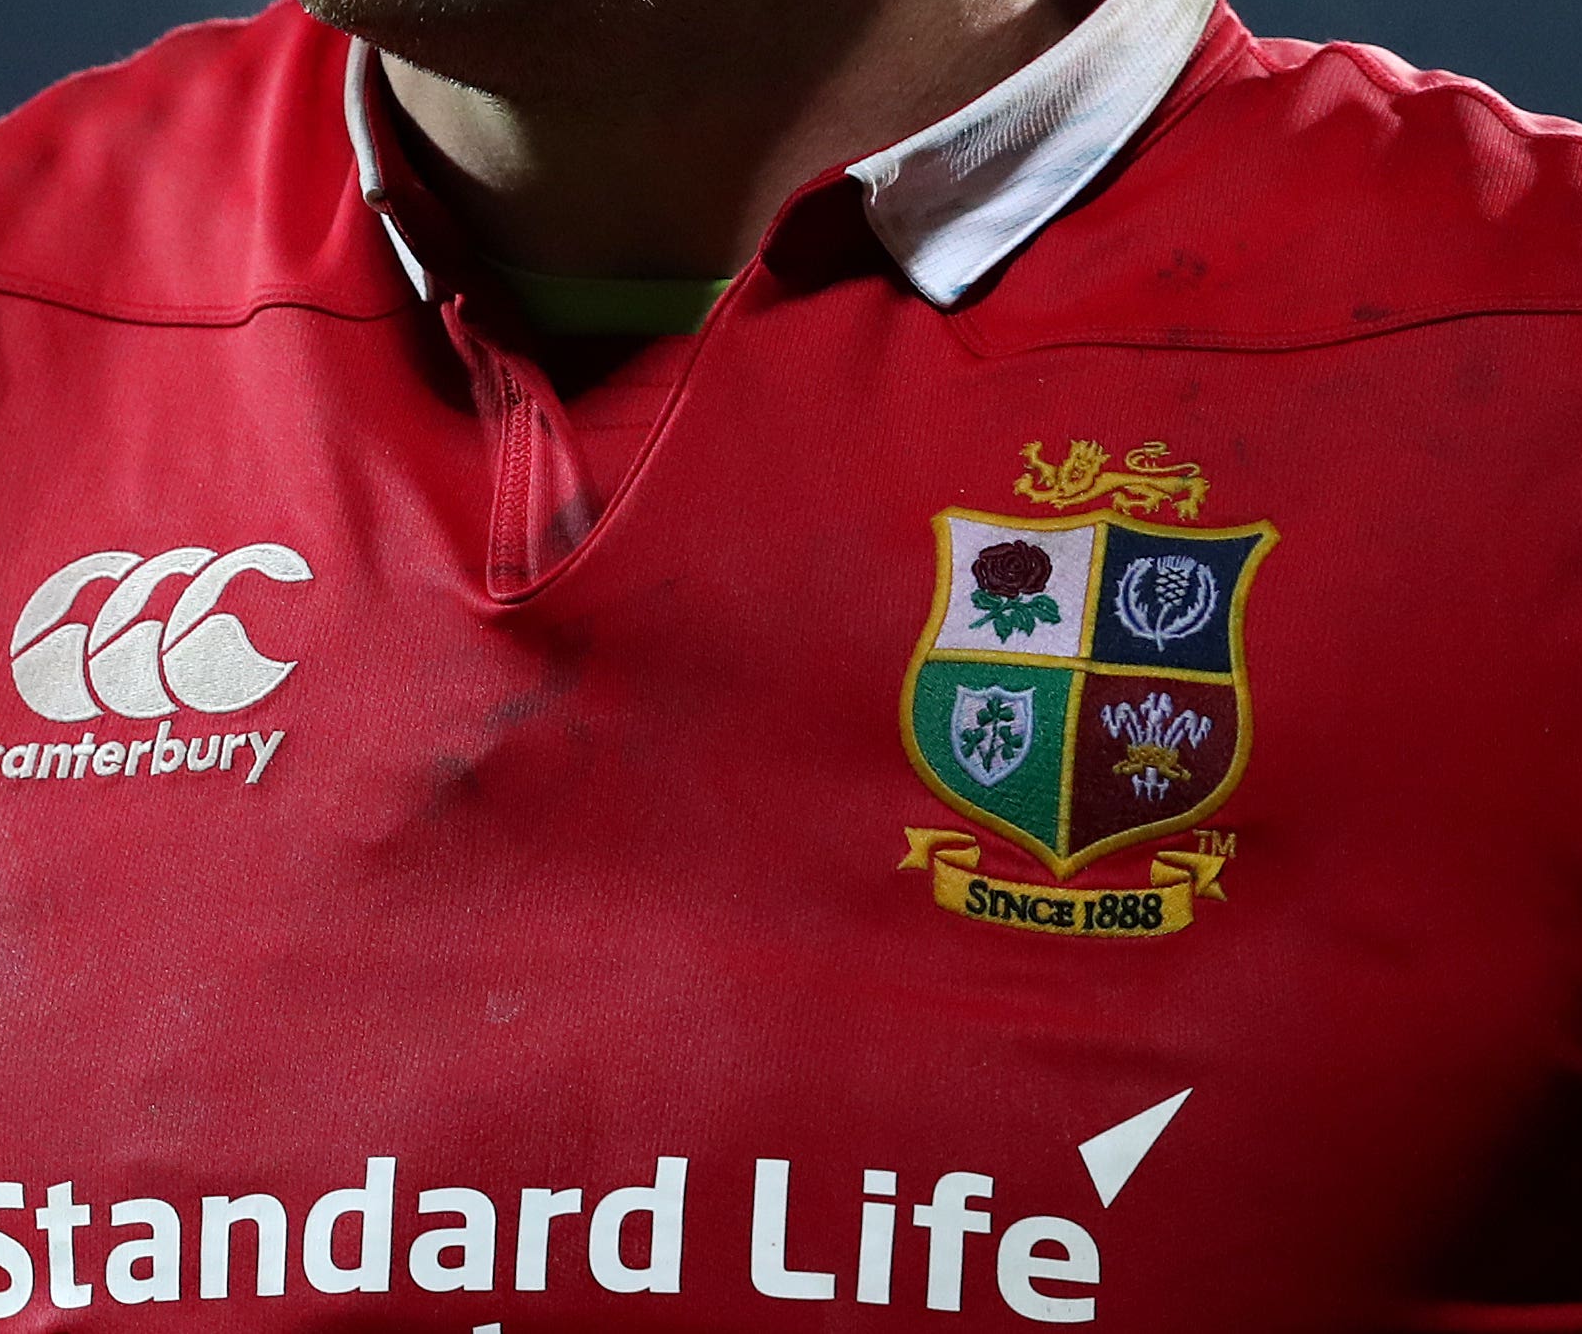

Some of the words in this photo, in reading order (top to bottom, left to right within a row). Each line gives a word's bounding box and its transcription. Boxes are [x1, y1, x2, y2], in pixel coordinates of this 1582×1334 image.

[1192, 829, 1238, 859] TM
[965, 878, 1076, 929] SINCE
[1083, 892, 1165, 932] 1888
[750, 1158, 1100, 1323] Life
